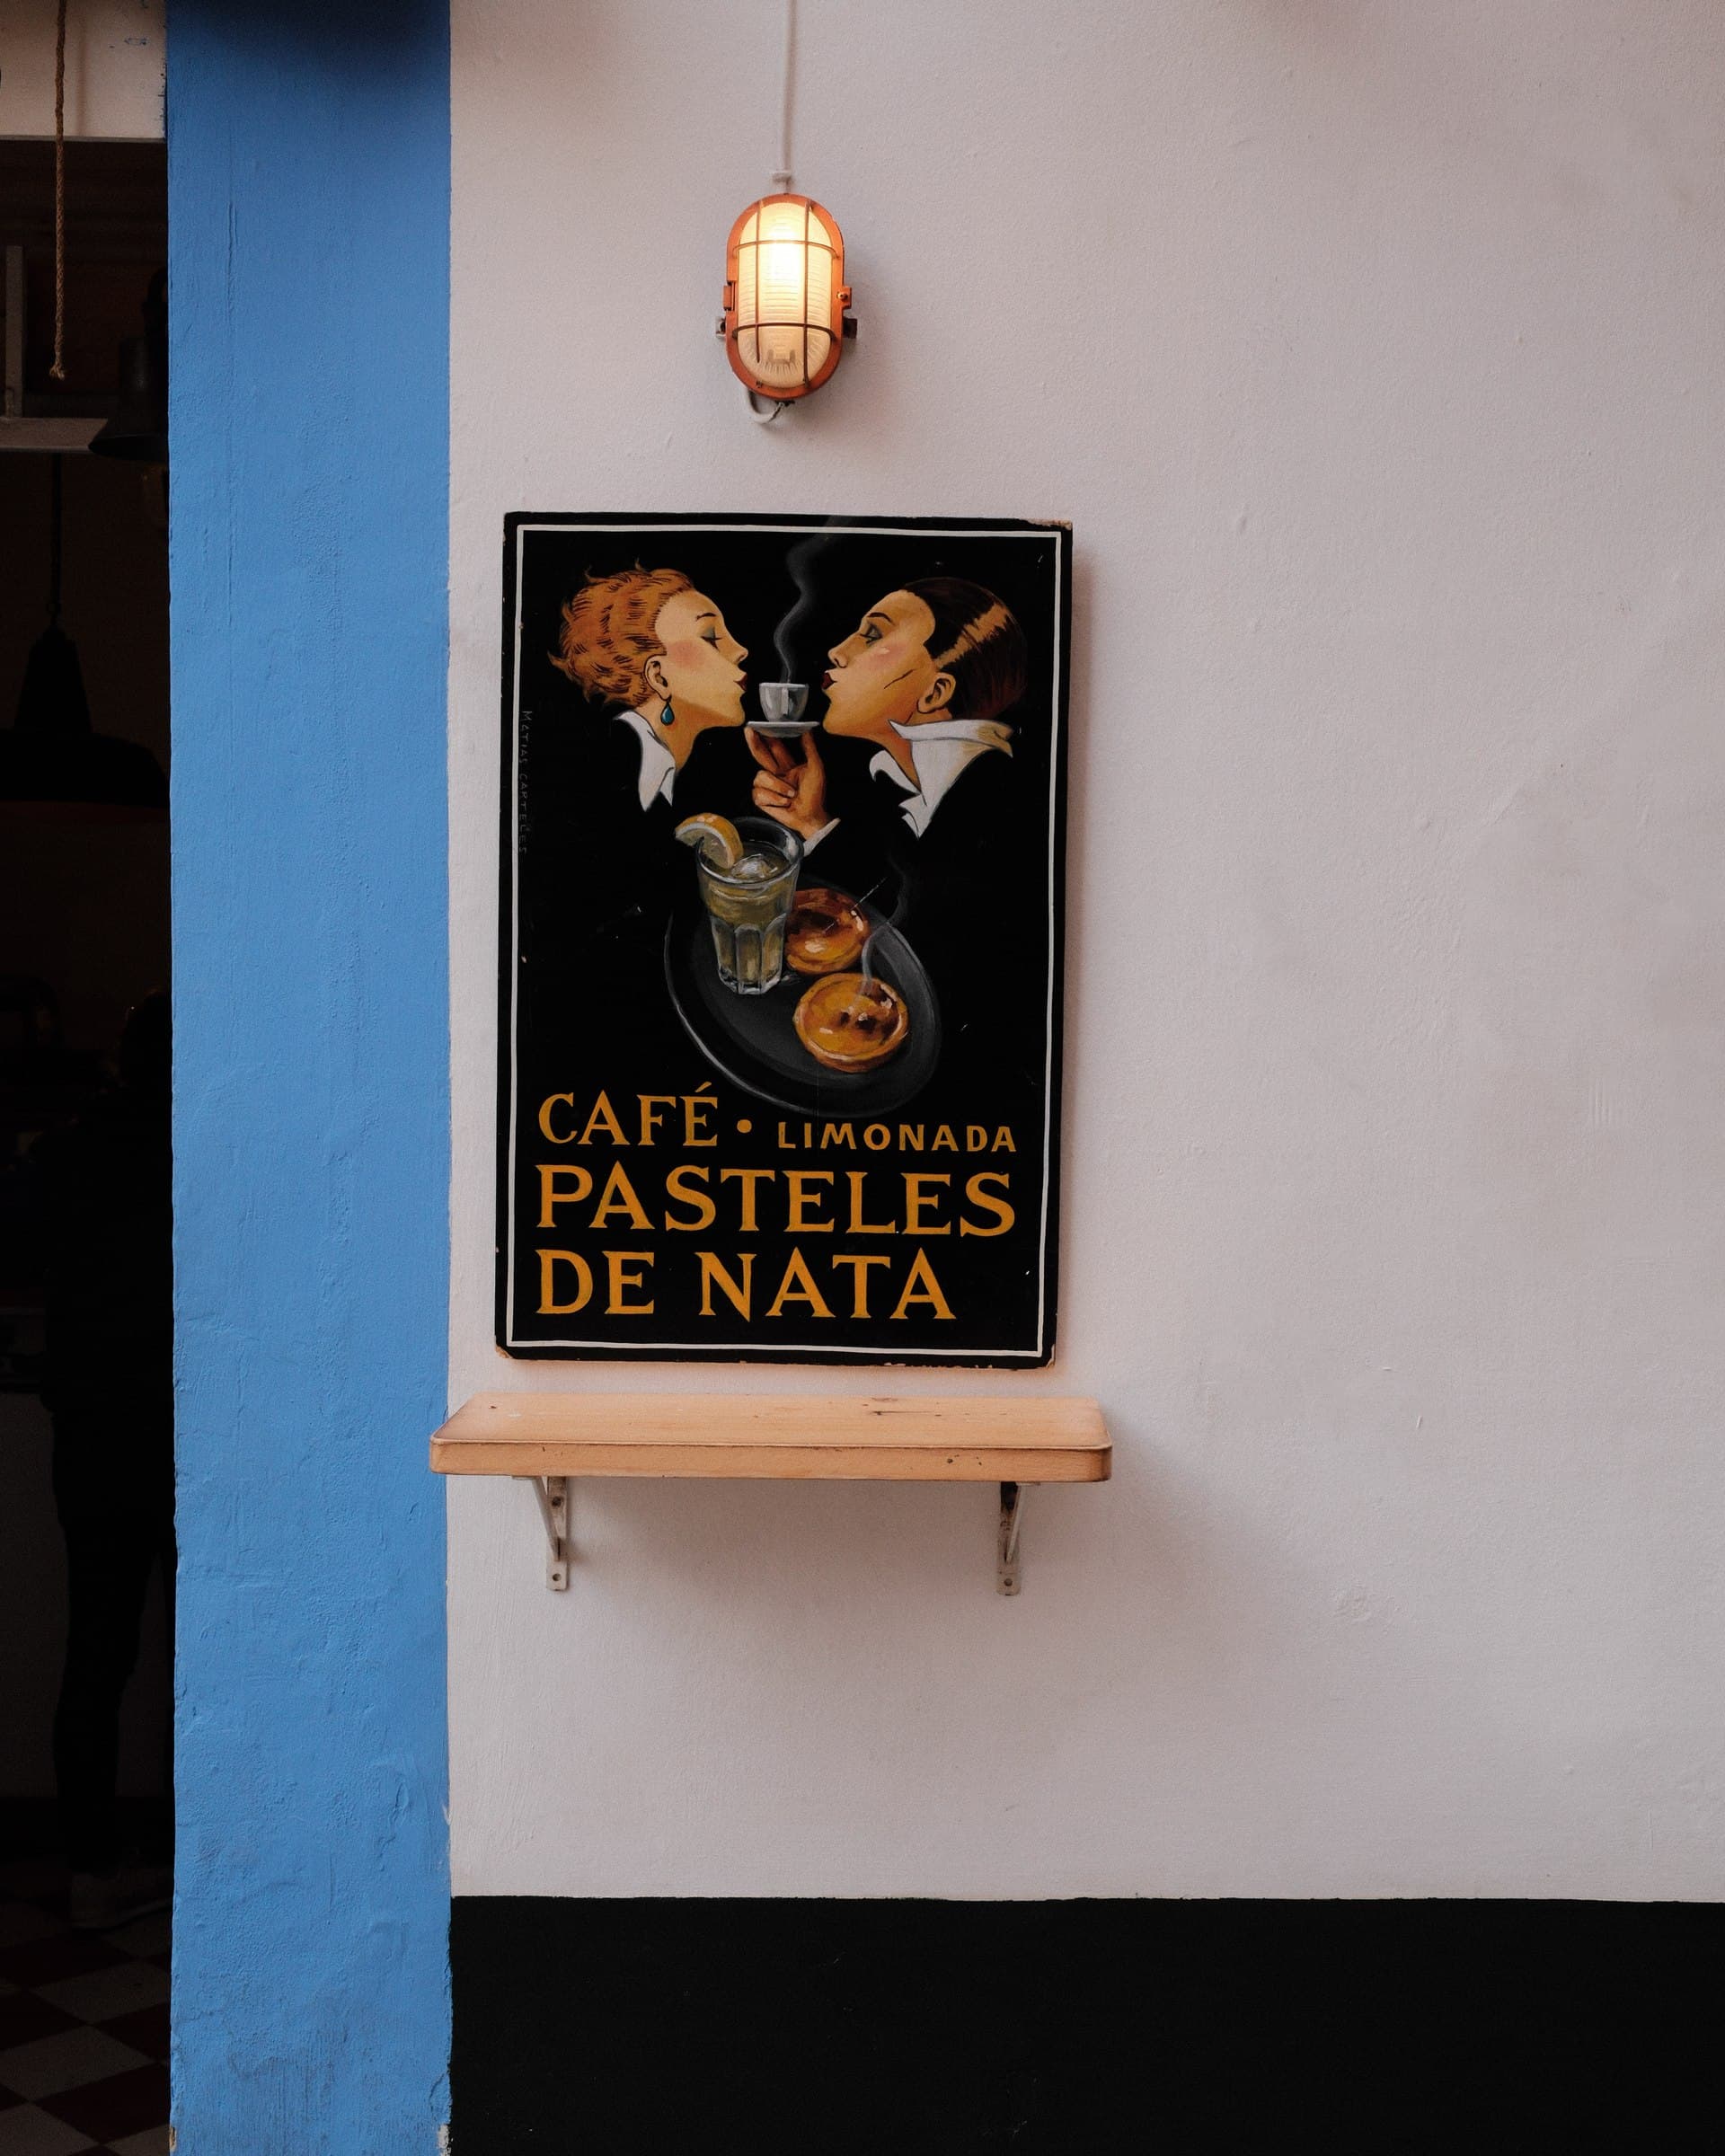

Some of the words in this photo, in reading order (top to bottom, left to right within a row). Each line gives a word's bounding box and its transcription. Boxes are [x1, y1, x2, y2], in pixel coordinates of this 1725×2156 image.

[538, 1081, 719, 1147] CAFÉ
[777, 1121, 1016, 1153] LIMONADA
[535, 1161, 1016, 1237] PASTELES
[535, 1248, 655, 1315] DE
[695, 1246, 957, 1322] NATA
